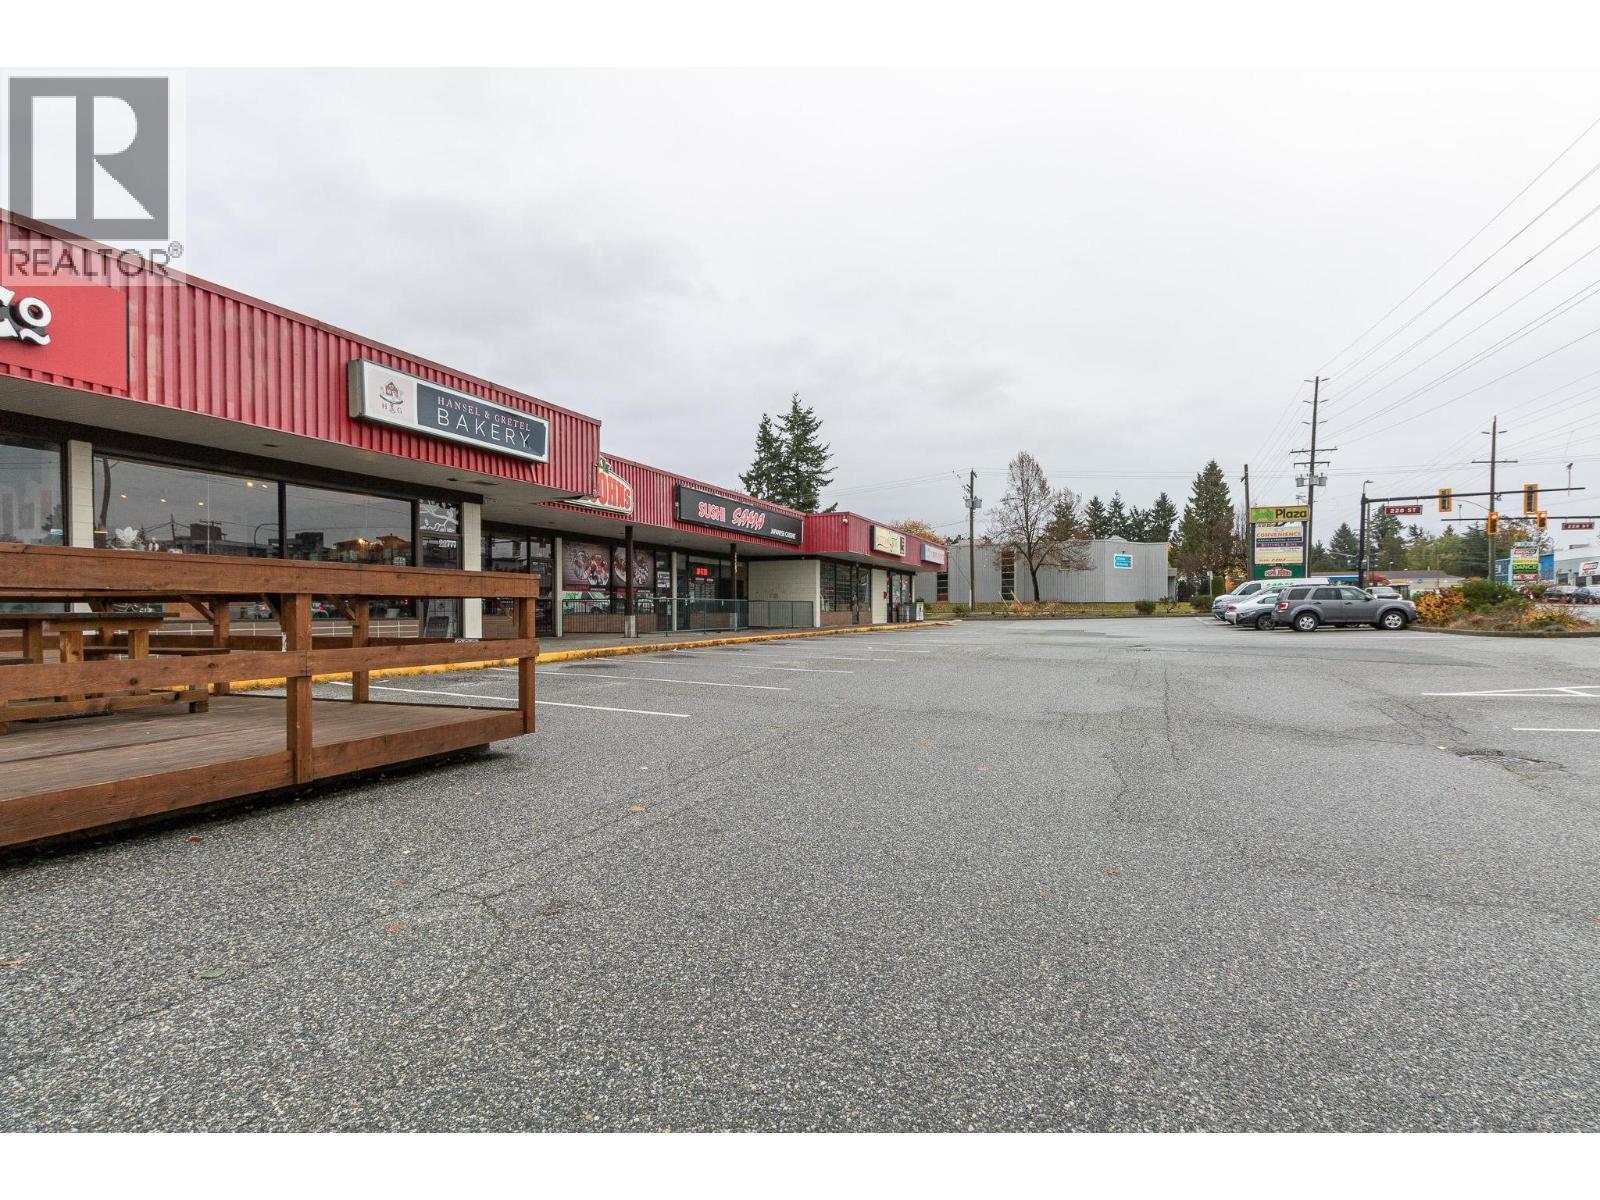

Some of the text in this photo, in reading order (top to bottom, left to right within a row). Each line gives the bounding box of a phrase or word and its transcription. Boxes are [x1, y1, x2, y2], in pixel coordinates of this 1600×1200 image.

[437, 396, 531, 432] HANSEL & GRETEL
[437, 407, 530, 448] BAKERY
[591, 472, 631, 510] OHNS
[698, 501, 726, 523] SUSHI
[1275, 508, 1307, 519] Plaza
